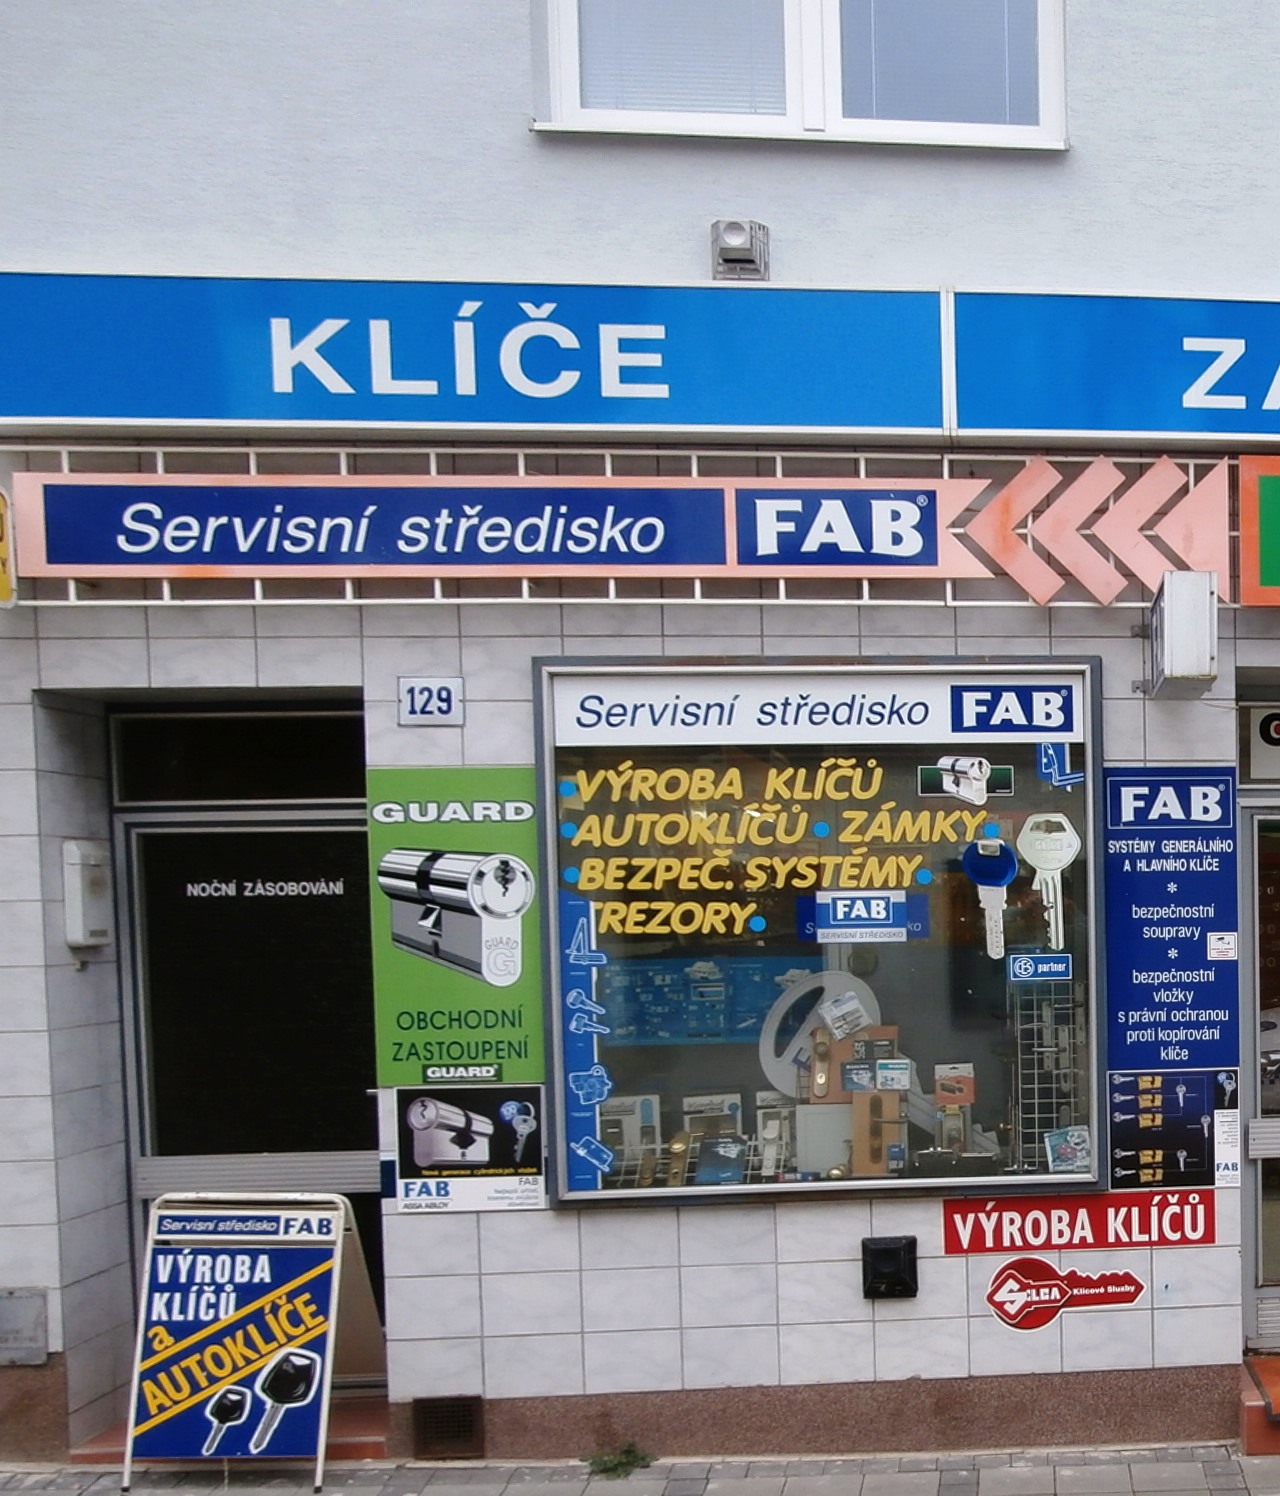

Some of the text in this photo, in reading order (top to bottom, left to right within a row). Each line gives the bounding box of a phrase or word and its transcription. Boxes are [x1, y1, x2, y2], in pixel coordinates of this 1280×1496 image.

[270, 300, 671, 398] KLÍČE
[116, 501, 666, 556] Servisní středisko
[406, 686, 452, 716] 129
[575, 693, 930, 730] Servisní středisko
[576, 757, 883, 802] VÝROBA KLÍČŮ
[372, 801, 535, 824] GUARD
[571, 801, 987, 847] AUTOKLÍČŮ ZÁMKY
[1108, 836, 1234, 853] SYSTÉMY GENERÁLNÍHO
[577, 846, 924, 892] BEZPEČ. SYSTÉMY
[1123, 855, 1220, 872] A HLAVNÍHO KLÍČE
[187, 877, 344, 897] NOČNÍ ZÁSOBOVÁNÍ
[593, 900, 758, 935] REZORY
[836, 899, 888, 920] FAB
[1132, 903, 1215, 921] bezpečnostní
[820, 931, 904, 939] SERVISNÍ STŘEDISKO
[1142, 926, 1201, 941] soupravy
[1037, 962, 1067, 974] partner
[1132, 968, 1215, 986] bezpečnostní
[1153, 988, 1194, 1004] vložky
[396, 1004, 524, 1031] OBCHODNÍ
[1118, 1008, 1229, 1025] s právní ochranou
[1126, 1025, 1221, 1044] proti kopírování
[392, 1034, 530, 1062] ZASTOUPENÍ
[1160, 1046, 1189, 1061] klíče
[427, 1065, 496, 1079] GUARD
[1216, 1162, 1239, 1172] FAB
[404, 1180, 450, 1198] FAB
[518, 1177, 539, 1186] FAB
[160, 1218, 278, 1232] Servisní středisko
[283, 1218, 333, 1236] FAB
[953, 1193, 1206, 1250] VÝROBA KLÍČŮ
[156, 1248, 272, 1284] VÝROBA
[151, 1284, 237, 1321] KLÍČŮ
[147, 1324, 176, 1351] a
[141, 1292, 326, 1416] AUTOKLÍČE
